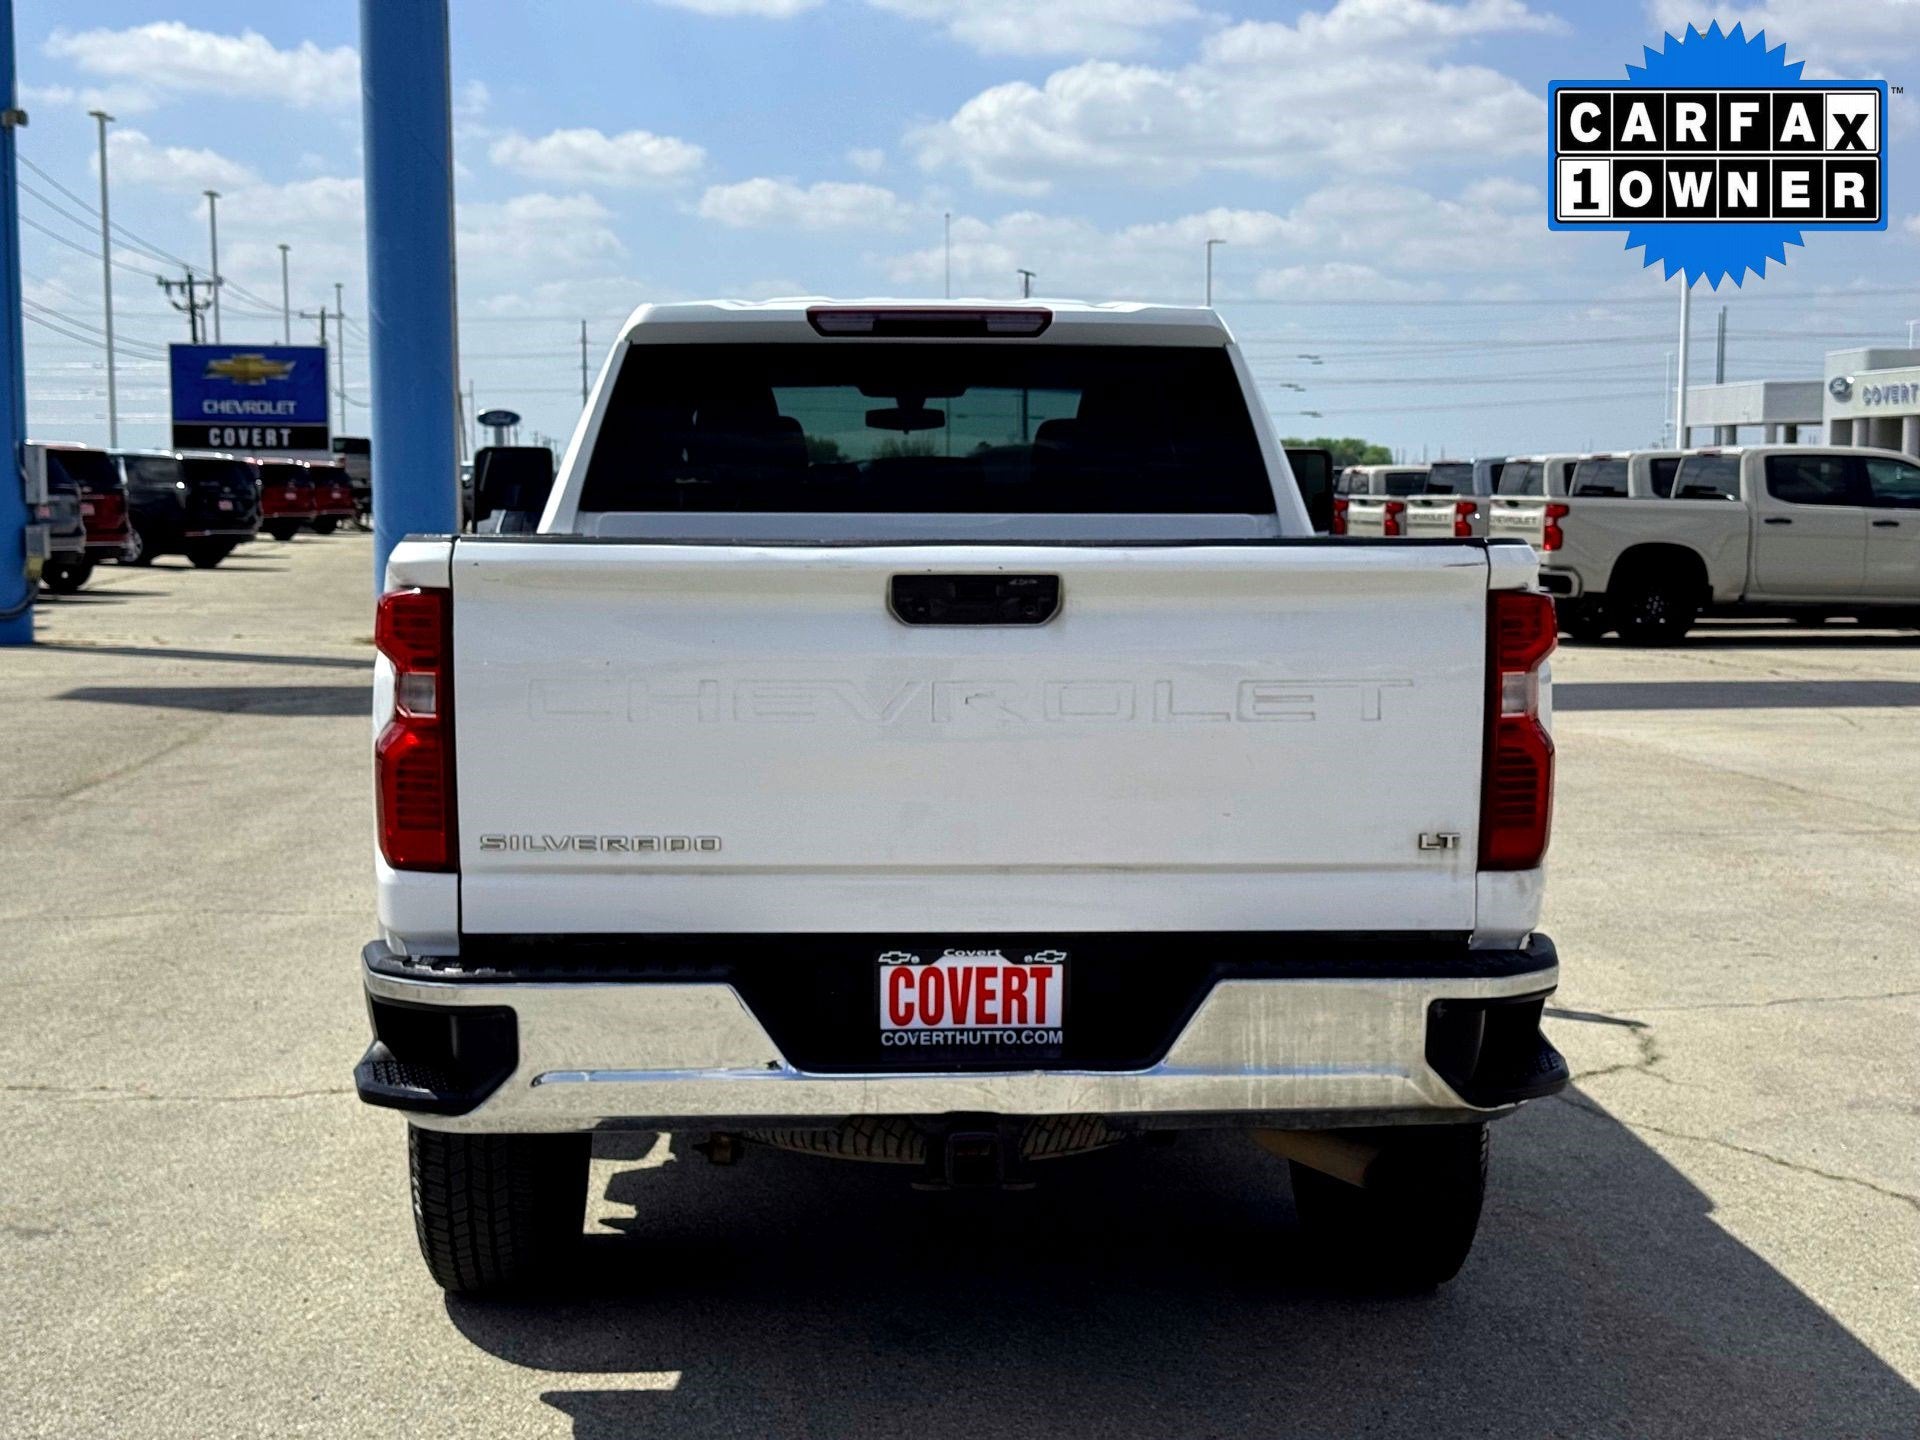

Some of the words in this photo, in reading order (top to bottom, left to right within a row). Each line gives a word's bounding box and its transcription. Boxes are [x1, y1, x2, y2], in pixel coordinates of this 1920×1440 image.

[1862, 383, 1919, 406] COVERT
[203, 400, 297, 415] CHEVROLET
[209, 427, 292, 447] COVERT
[528, 679, 1413, 723] CHEVROLET
[479, 834, 722, 852] SILVERADO
[1418, 832, 1461, 850] LT
[943, 948, 1002, 957] Covert
[889, 966, 1053, 1026] COVERT
[881, 1030, 1064, 1046] COVERTHUTTO.COM
